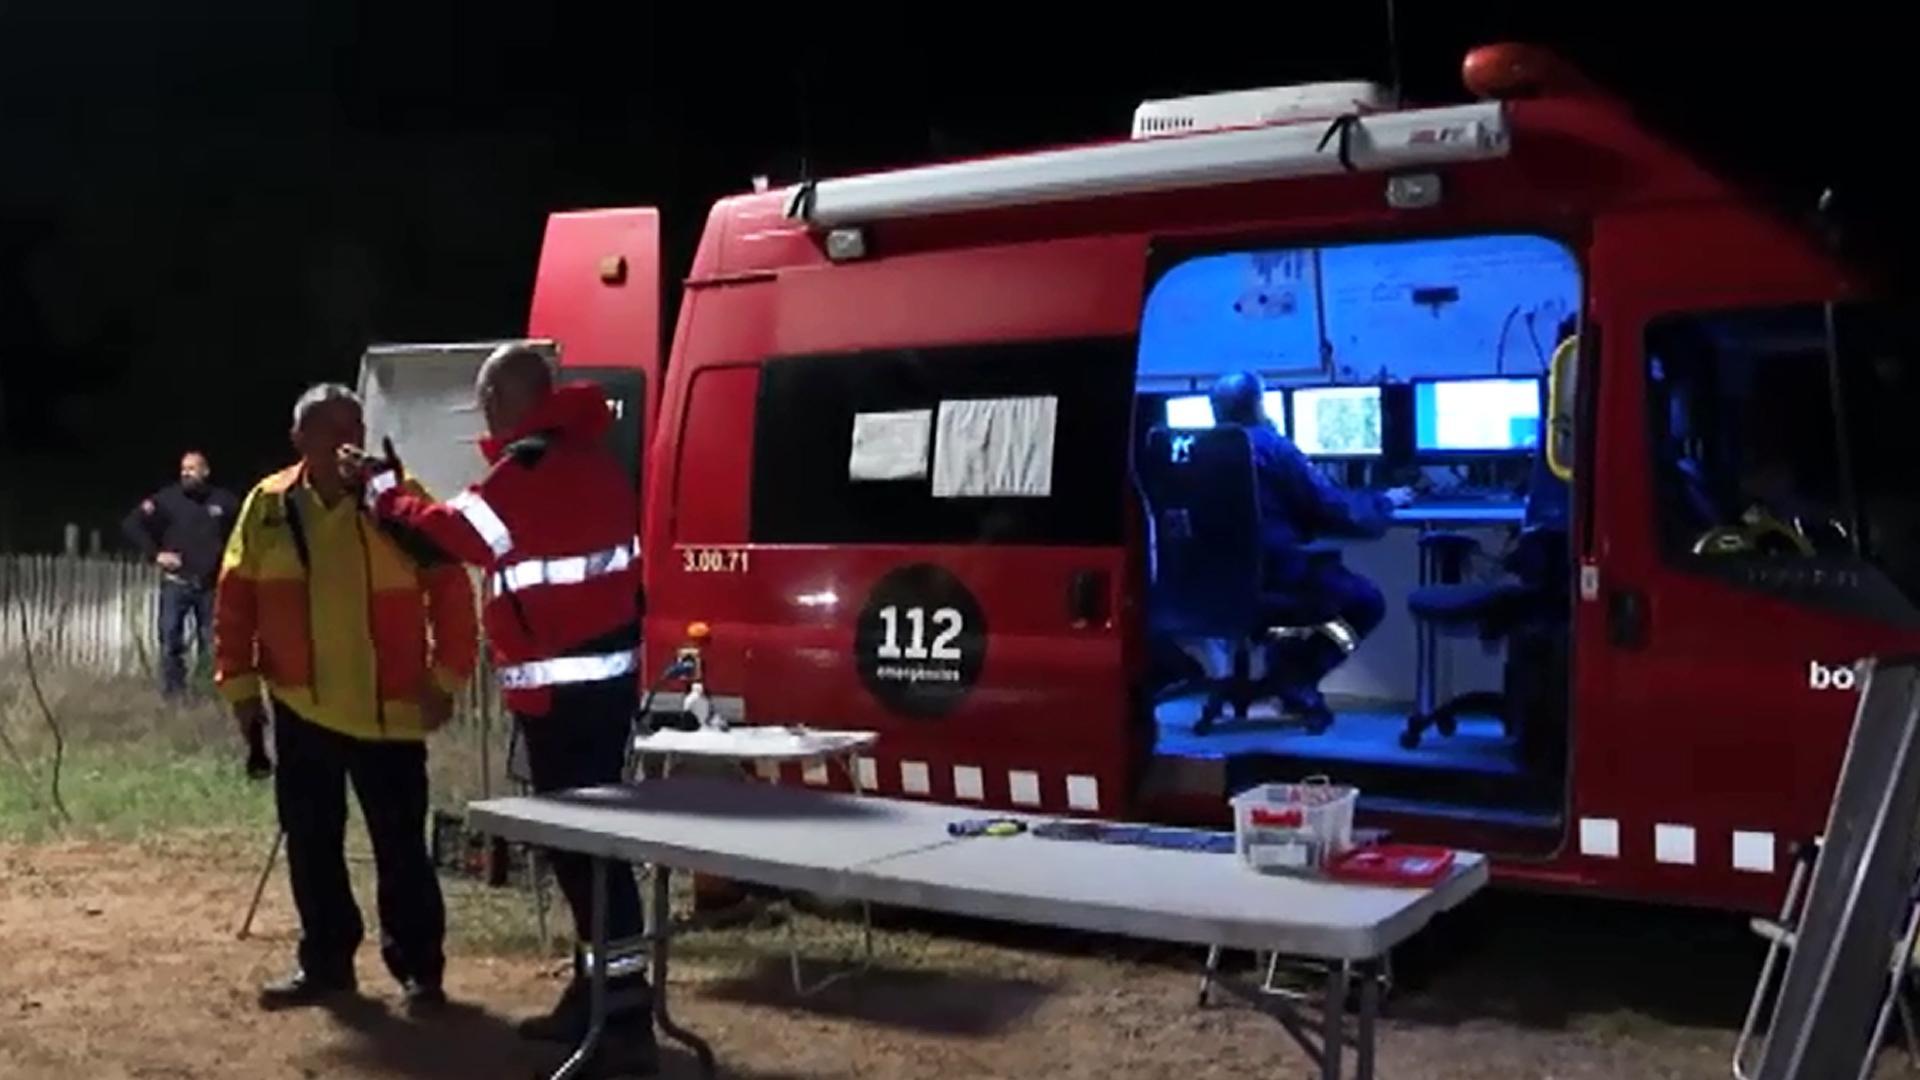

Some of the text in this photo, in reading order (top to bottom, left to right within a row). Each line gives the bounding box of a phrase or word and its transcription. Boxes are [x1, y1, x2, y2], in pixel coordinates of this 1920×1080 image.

[605, 399, 624, 419] 71
[683, 550, 748, 572] 3.00.71
[878, 605, 963, 659] 112
[1810, 660, 1855, 690] bo
